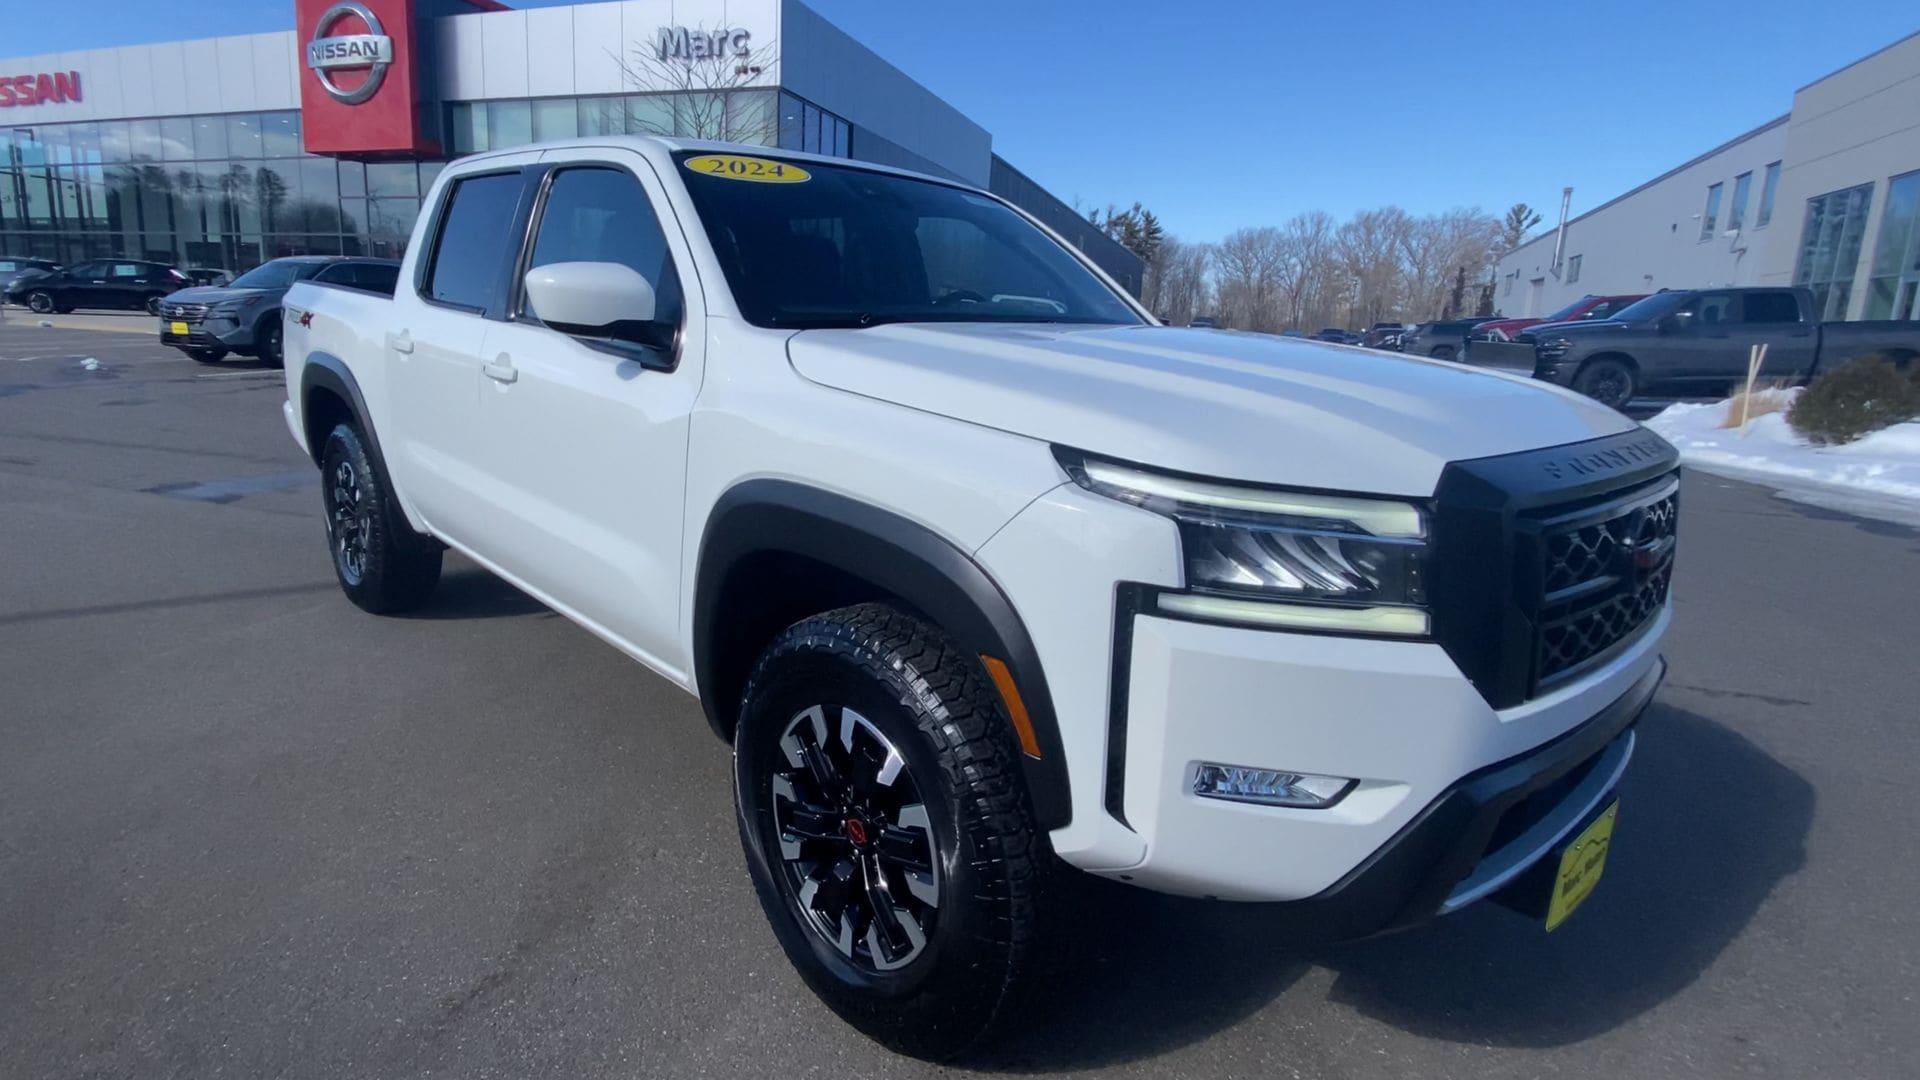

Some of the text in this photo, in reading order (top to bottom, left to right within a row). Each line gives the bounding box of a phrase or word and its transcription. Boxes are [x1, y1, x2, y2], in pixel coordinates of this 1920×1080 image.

[311, 41, 379, 61] NISSAN
[656, 26, 751, 62] Marc
[707, 159, 784, 177] 2024
